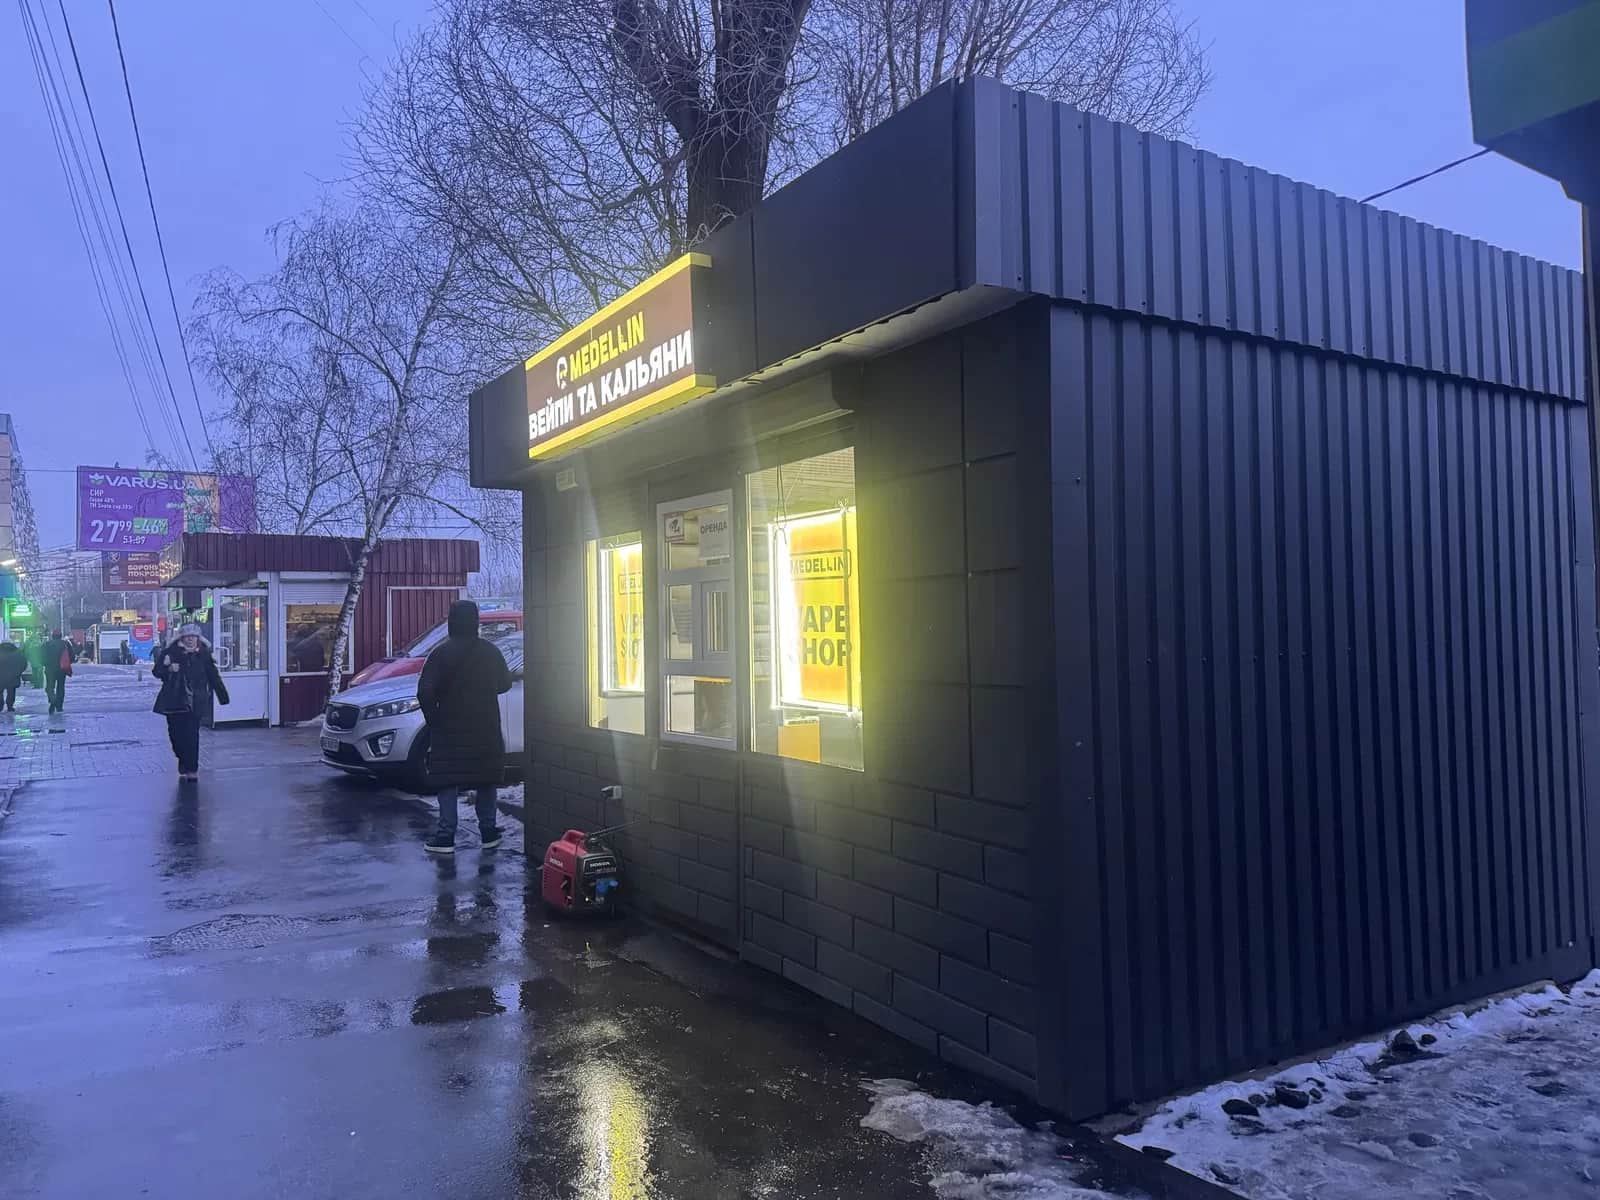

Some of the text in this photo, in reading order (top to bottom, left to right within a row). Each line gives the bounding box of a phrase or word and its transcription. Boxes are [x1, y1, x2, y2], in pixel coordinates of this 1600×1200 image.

[570, 311, 645, 382] MEDELLIN
[528, 329, 693, 440] ВЕЙПИ ТА КАЛЬЯНИ
[105, 475, 196, 489] VARUS.UA
[90, 519, 119, 543] 27
[791, 556, 846, 574] MEDELLIN
[799, 605, 848, 633] APE
[799, 638, 851, 667] HOP
